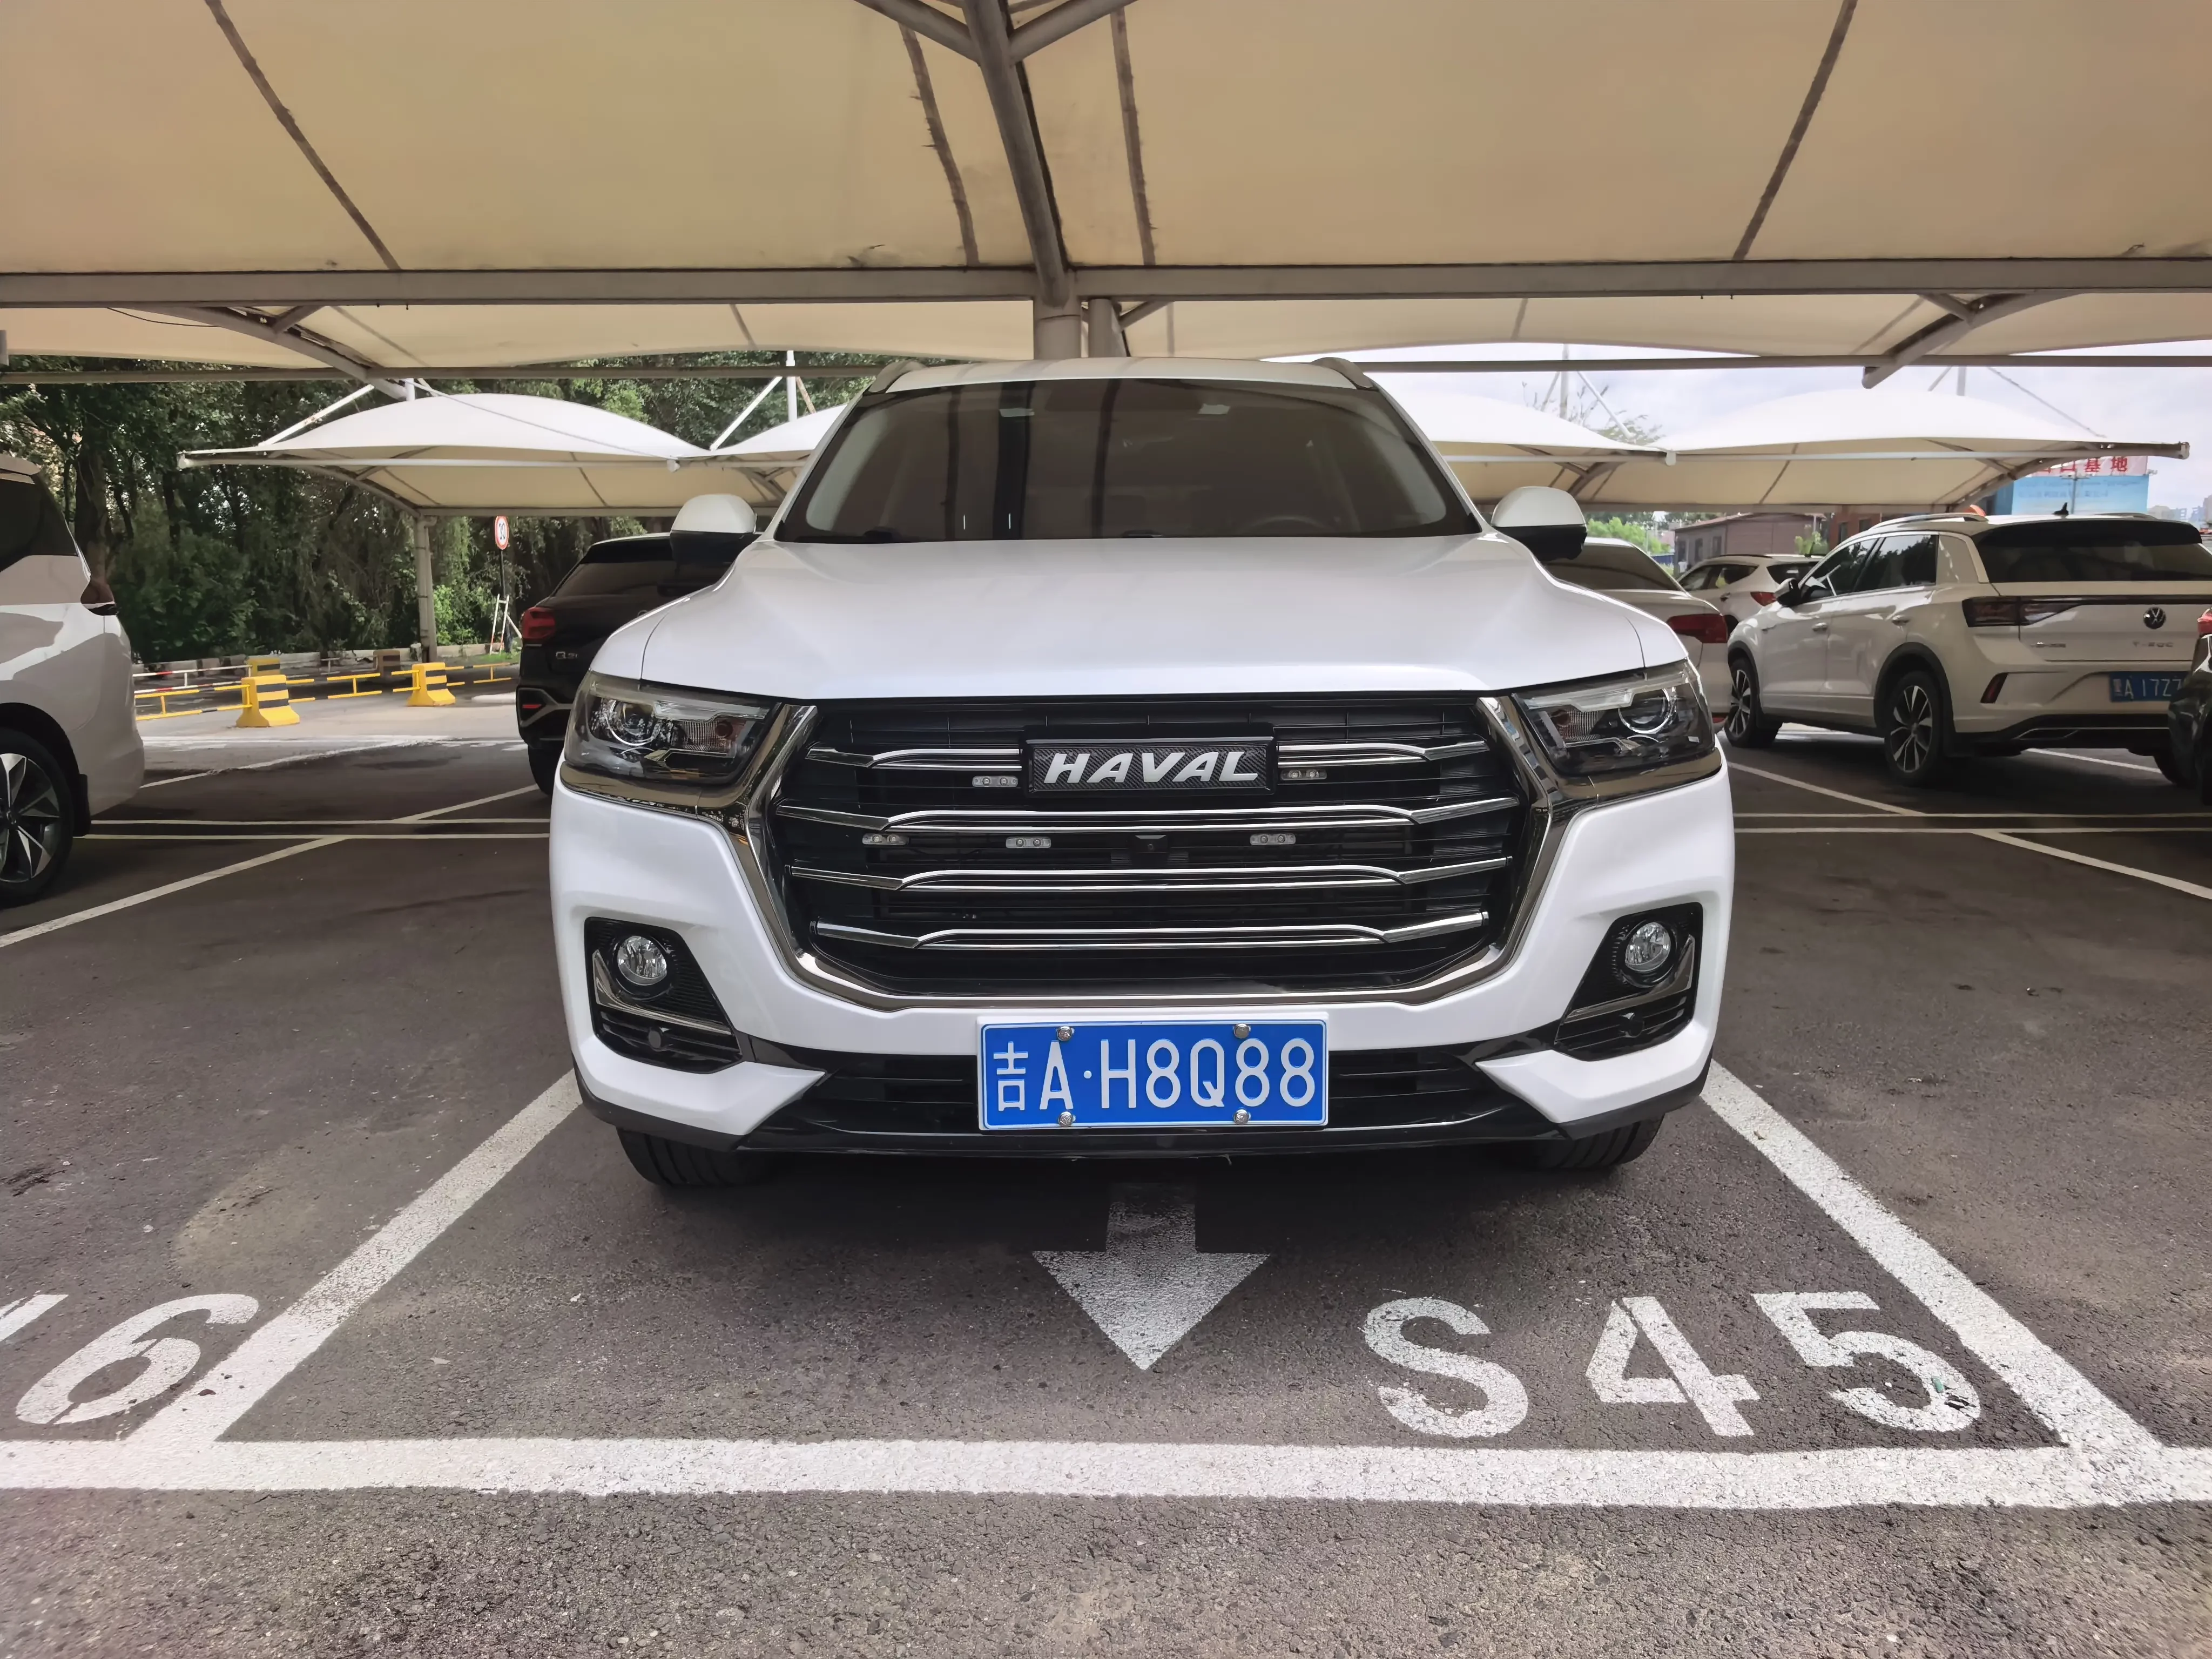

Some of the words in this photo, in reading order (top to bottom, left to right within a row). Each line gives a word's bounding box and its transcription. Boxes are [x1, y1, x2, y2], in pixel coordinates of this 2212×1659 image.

[499, 523, 506, 540] 30
[1043, 751, 1258, 784] HAVAL
[993, 1038, 1316, 1111] 吉A·H8Q88
